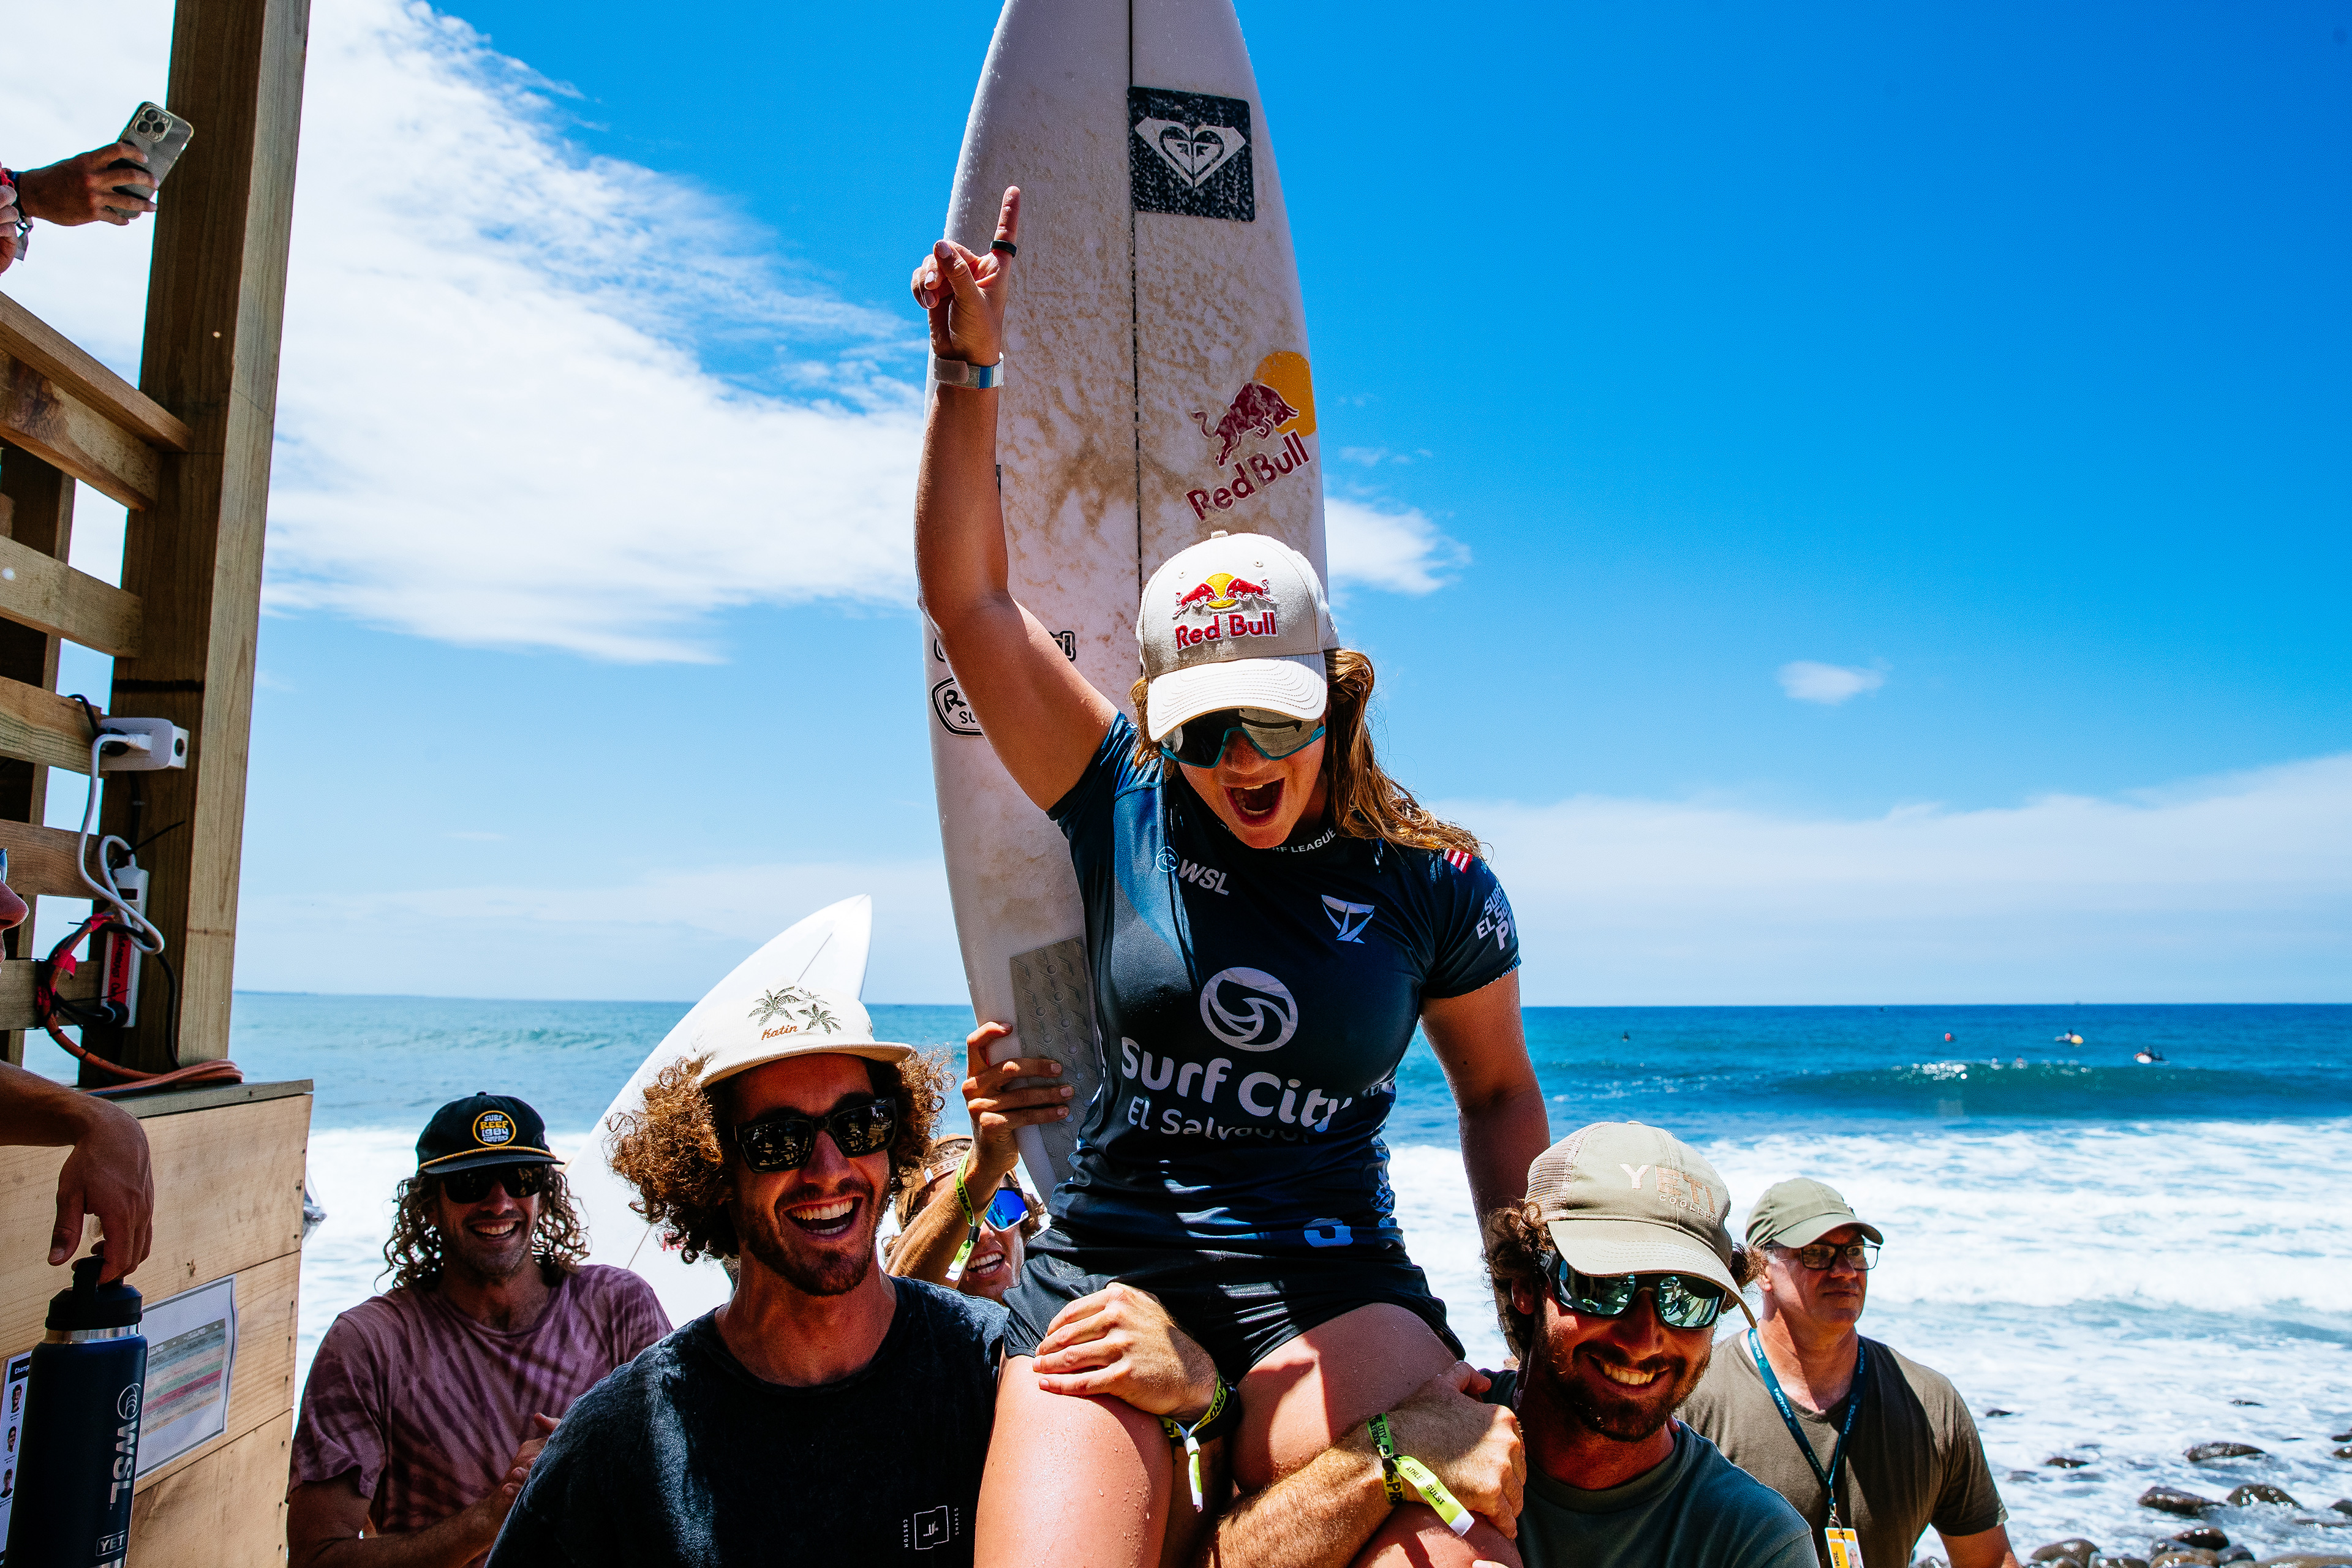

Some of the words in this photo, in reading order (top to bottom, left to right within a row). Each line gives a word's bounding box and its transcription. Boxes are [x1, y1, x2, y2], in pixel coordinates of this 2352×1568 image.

[1187, 462, 1254, 520] Red
[1250, 431, 1309, 484] Bull
[1175, 614, 1221, 649] Red
[1228, 611, 1277, 636] Bull
[1291, 827, 1336, 853] LEAGUE
[1178, 859, 1229, 895] WSL
[1476, 917, 1495, 940] EL
[761, 1024, 798, 1040] Katin
[1121, 1036, 1232, 1103] Surf
[1238, 1071, 1352, 1133] City
[480, 1120, 508, 1130] REEF
[1128, 1096, 1150, 1131] El
[482, 1128, 509, 1137] 1984
[1619, 1164, 1716, 1214] YETI
[110, 1420, 138, 1504] WSL
[1405, 1466, 1426, 1486] ATHLET
[1426, 1484, 1446, 1506] GUEST
[100, 1533, 127, 1553] YETI
